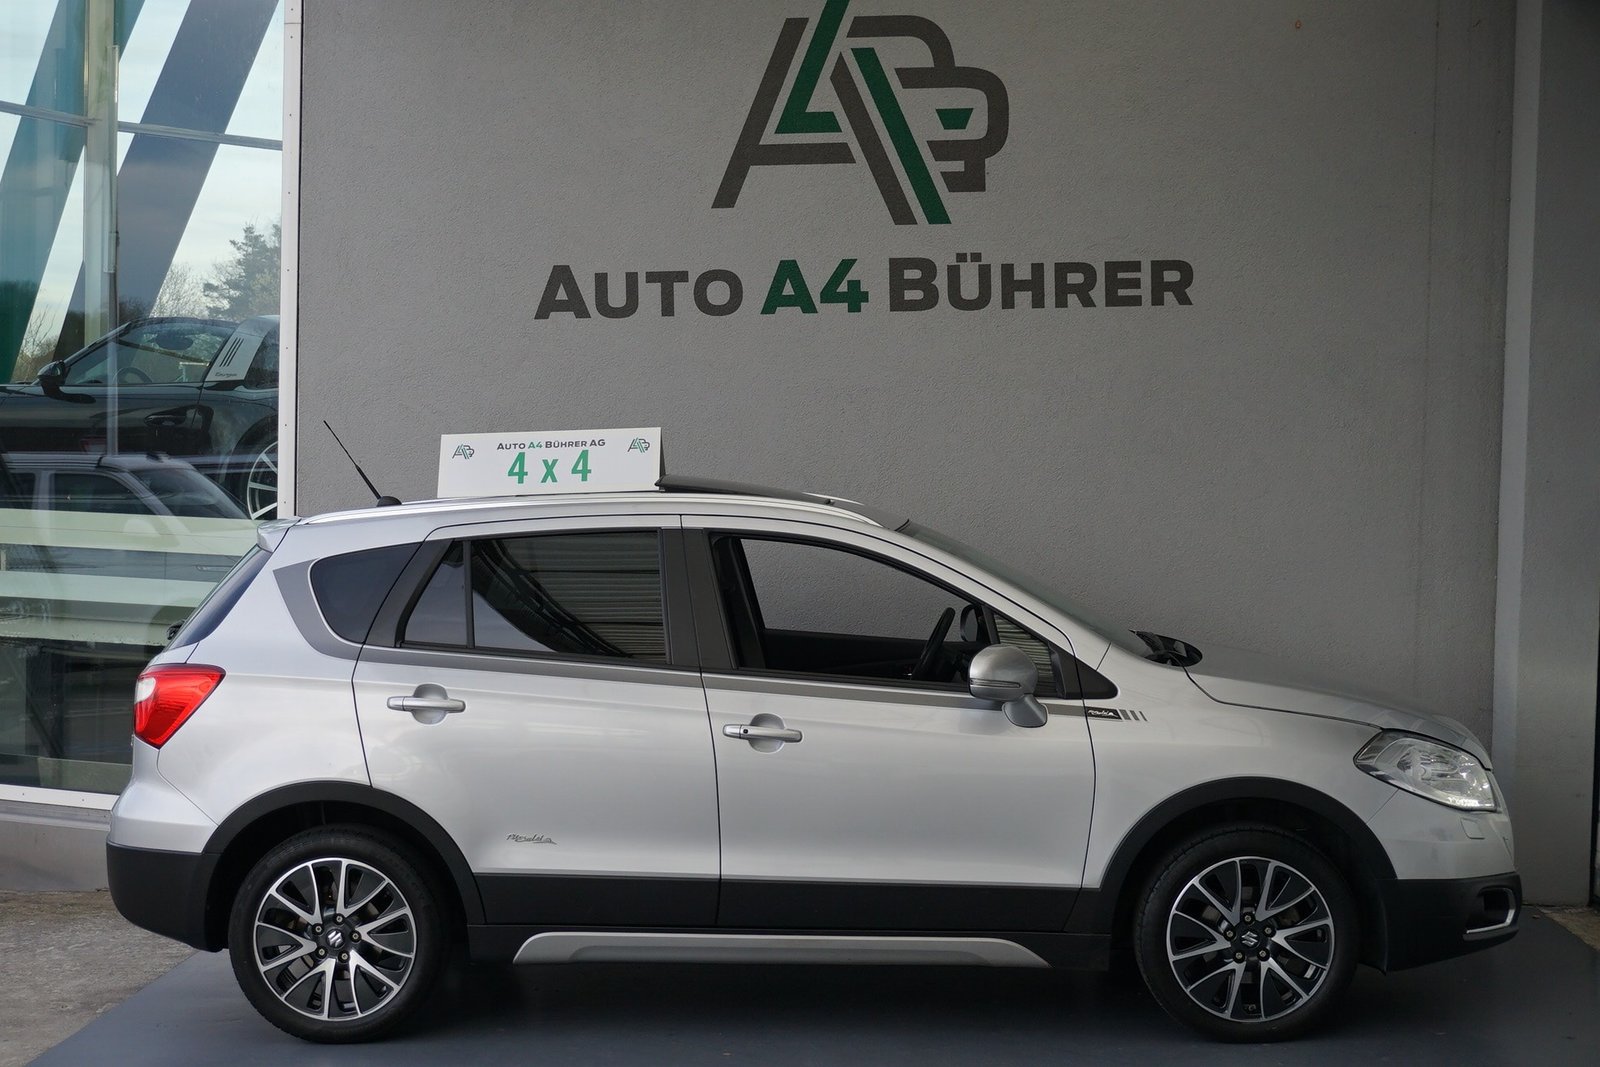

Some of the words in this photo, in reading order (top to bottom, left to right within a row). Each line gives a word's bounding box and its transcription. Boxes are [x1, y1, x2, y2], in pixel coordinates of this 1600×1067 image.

[533, 264, 744, 320] AUTO
[760, 258, 870, 315] A4
[888, 251, 1194, 313] BÜHRER
[496, 442, 526, 450] AUTO
[527, 441, 543, 449] A4
[545, 440, 587, 449] BÜHRER
[589, 438, 606, 447] AG
[507, 451, 529, 485] 4
[571, 449, 592, 482] 4
